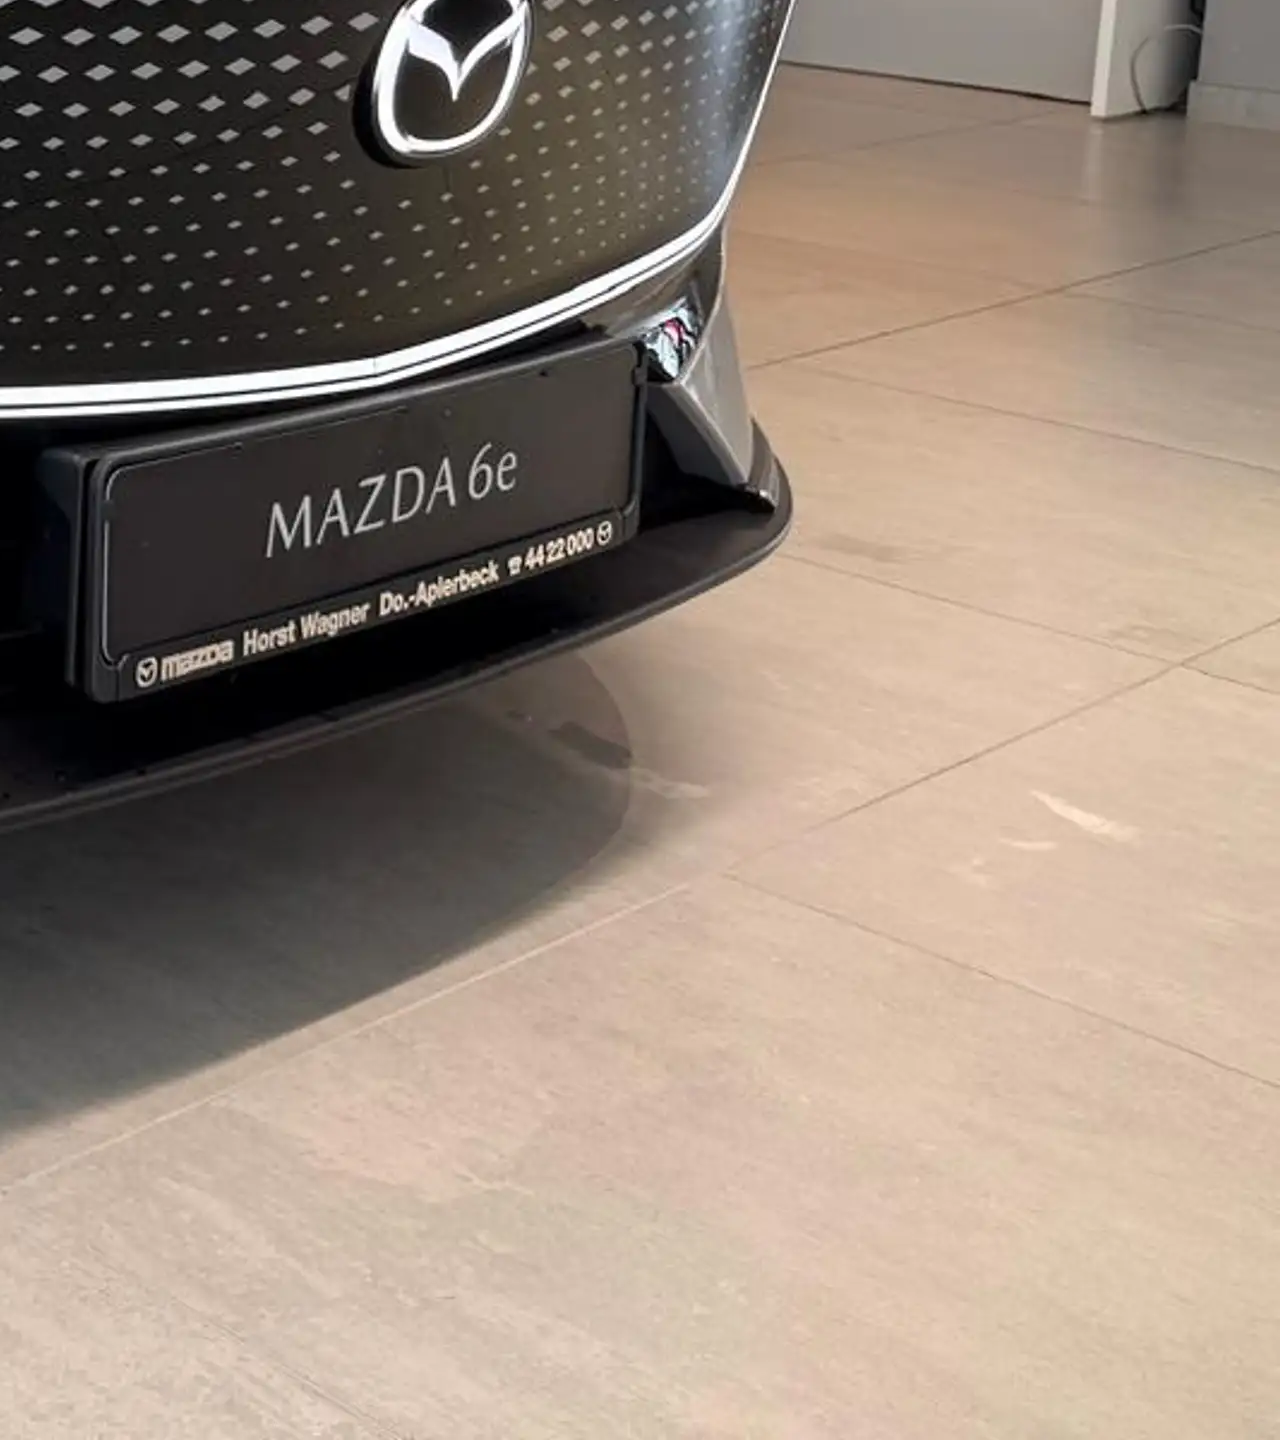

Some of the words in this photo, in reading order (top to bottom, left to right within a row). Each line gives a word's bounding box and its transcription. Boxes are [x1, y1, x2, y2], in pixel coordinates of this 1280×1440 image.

[265, 456, 457, 558] MAZDA
[468, 442, 518, 501] 6e
[160, 639, 235, 682] mazda
[242, 619, 297, 657] Horst
[300, 602, 370, 639] Wagner
